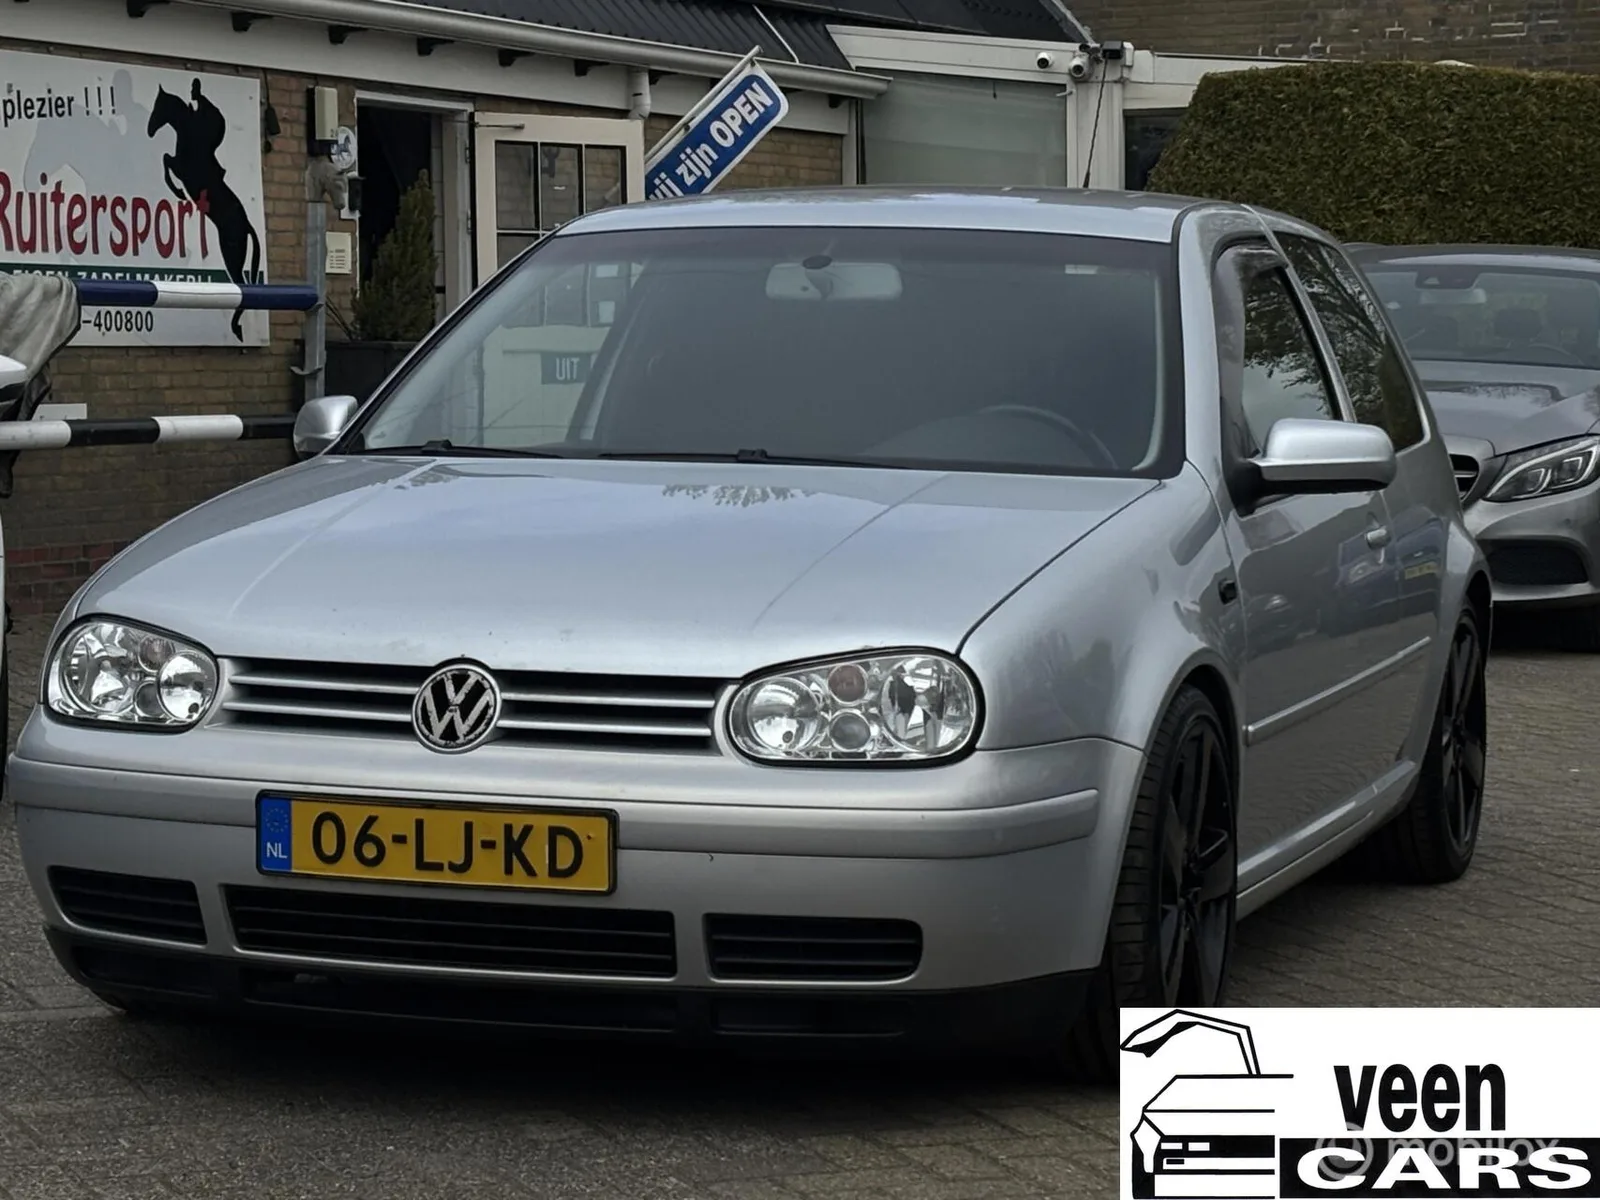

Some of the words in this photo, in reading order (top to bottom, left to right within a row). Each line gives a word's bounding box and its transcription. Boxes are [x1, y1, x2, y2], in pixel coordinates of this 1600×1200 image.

[2, 88, 74, 128] plezier
[675, 143, 719, 187] zijn
[709, 82, 774, 148] OPEN
[0, 171, 210, 260] Ruitersport
[555, 357, 580, 380] UIT
[265, 842, 288, 860] NL
[311, 811, 584, 879] 06-LJ-KD
